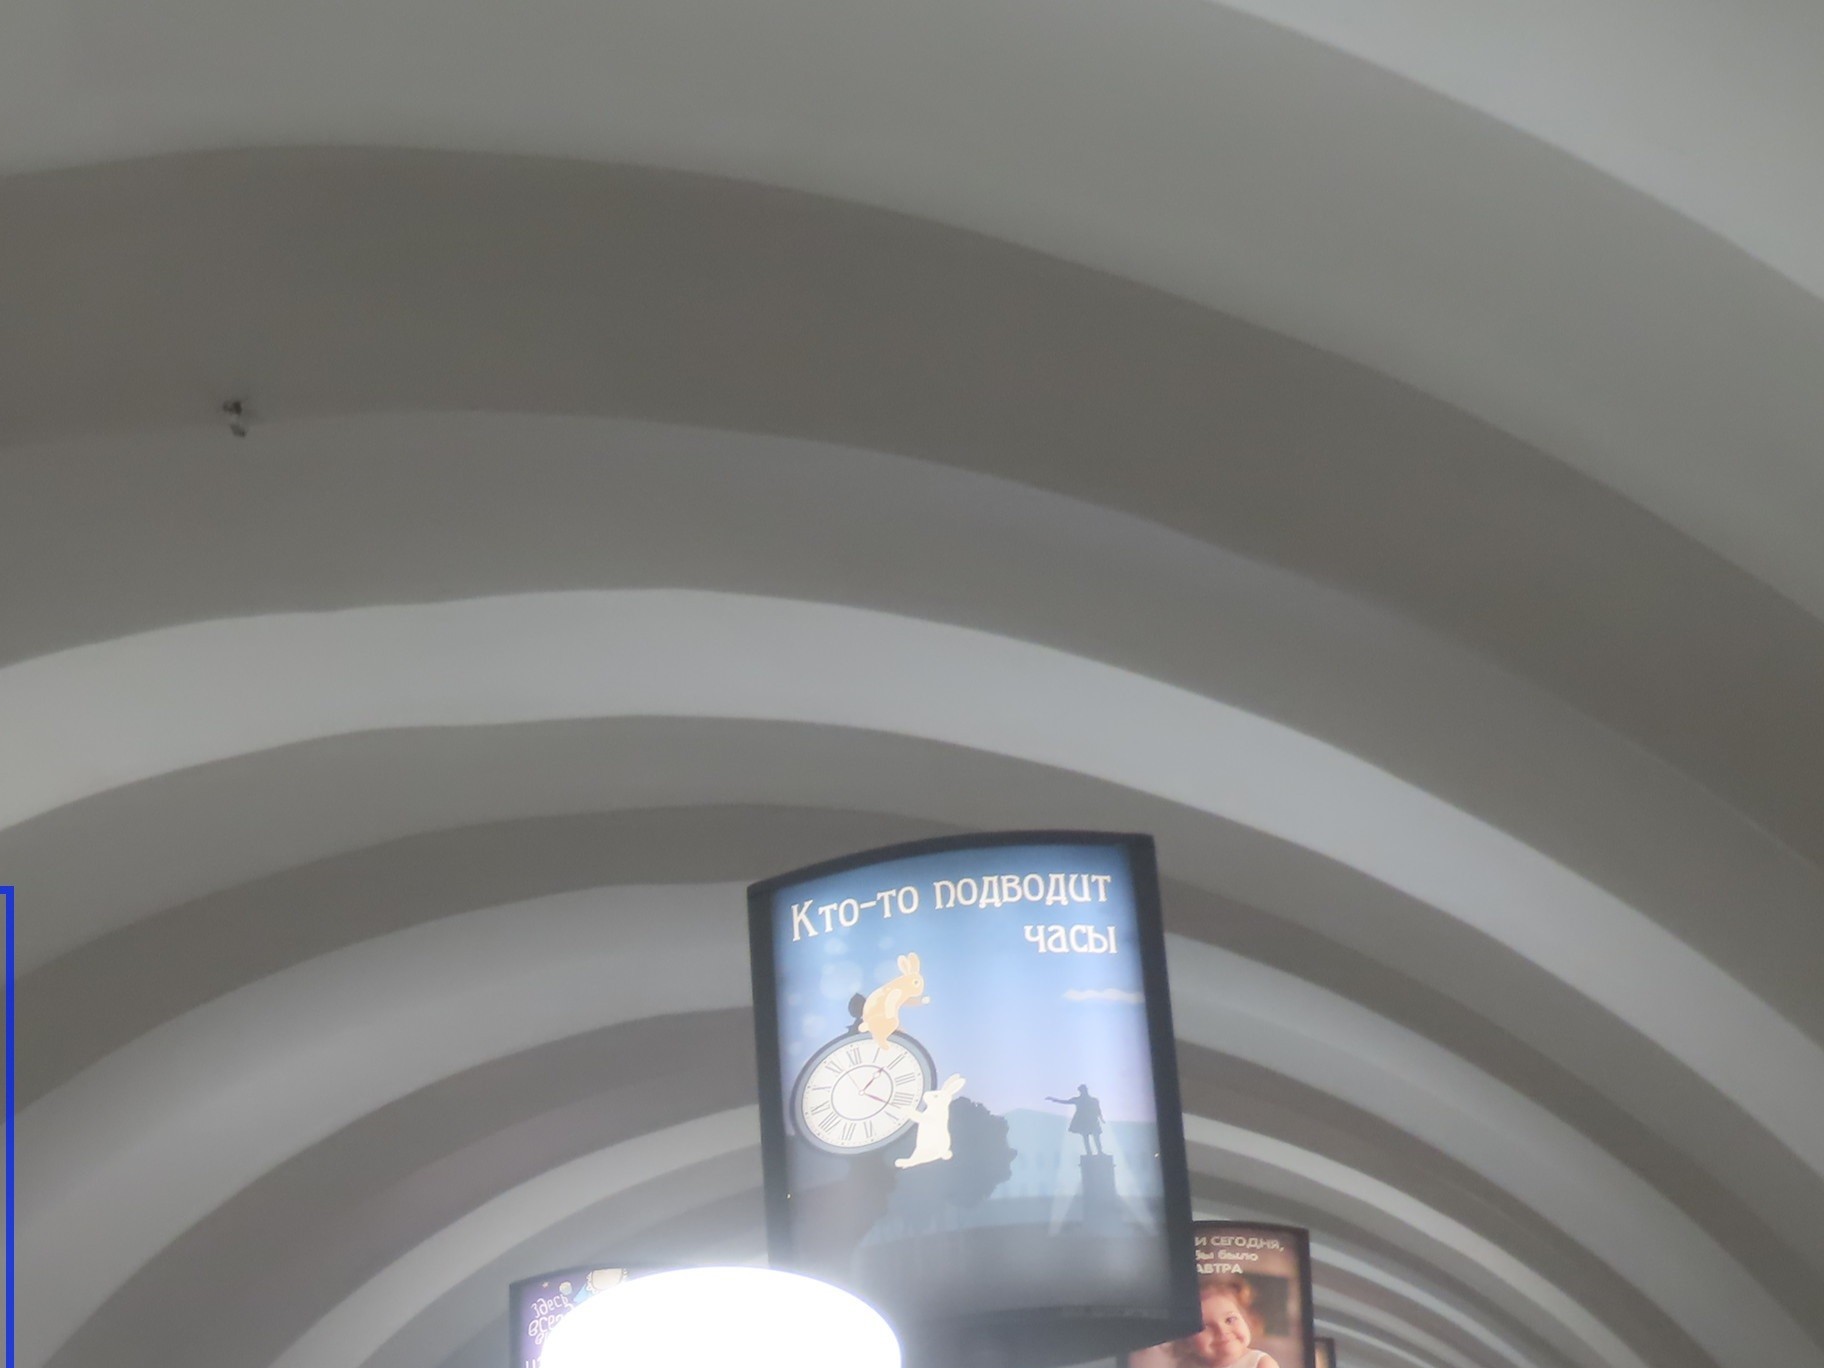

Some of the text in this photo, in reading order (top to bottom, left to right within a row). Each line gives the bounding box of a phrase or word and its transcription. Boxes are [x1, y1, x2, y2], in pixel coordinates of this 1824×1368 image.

[791, 873, 1112, 942] Кто-то подводит
[1024, 924, 1118, 954] часы
[1210, 1236, 1285, 1252] СЕГОДНЯ,
[1218, 1249, 1259, 1261] было
